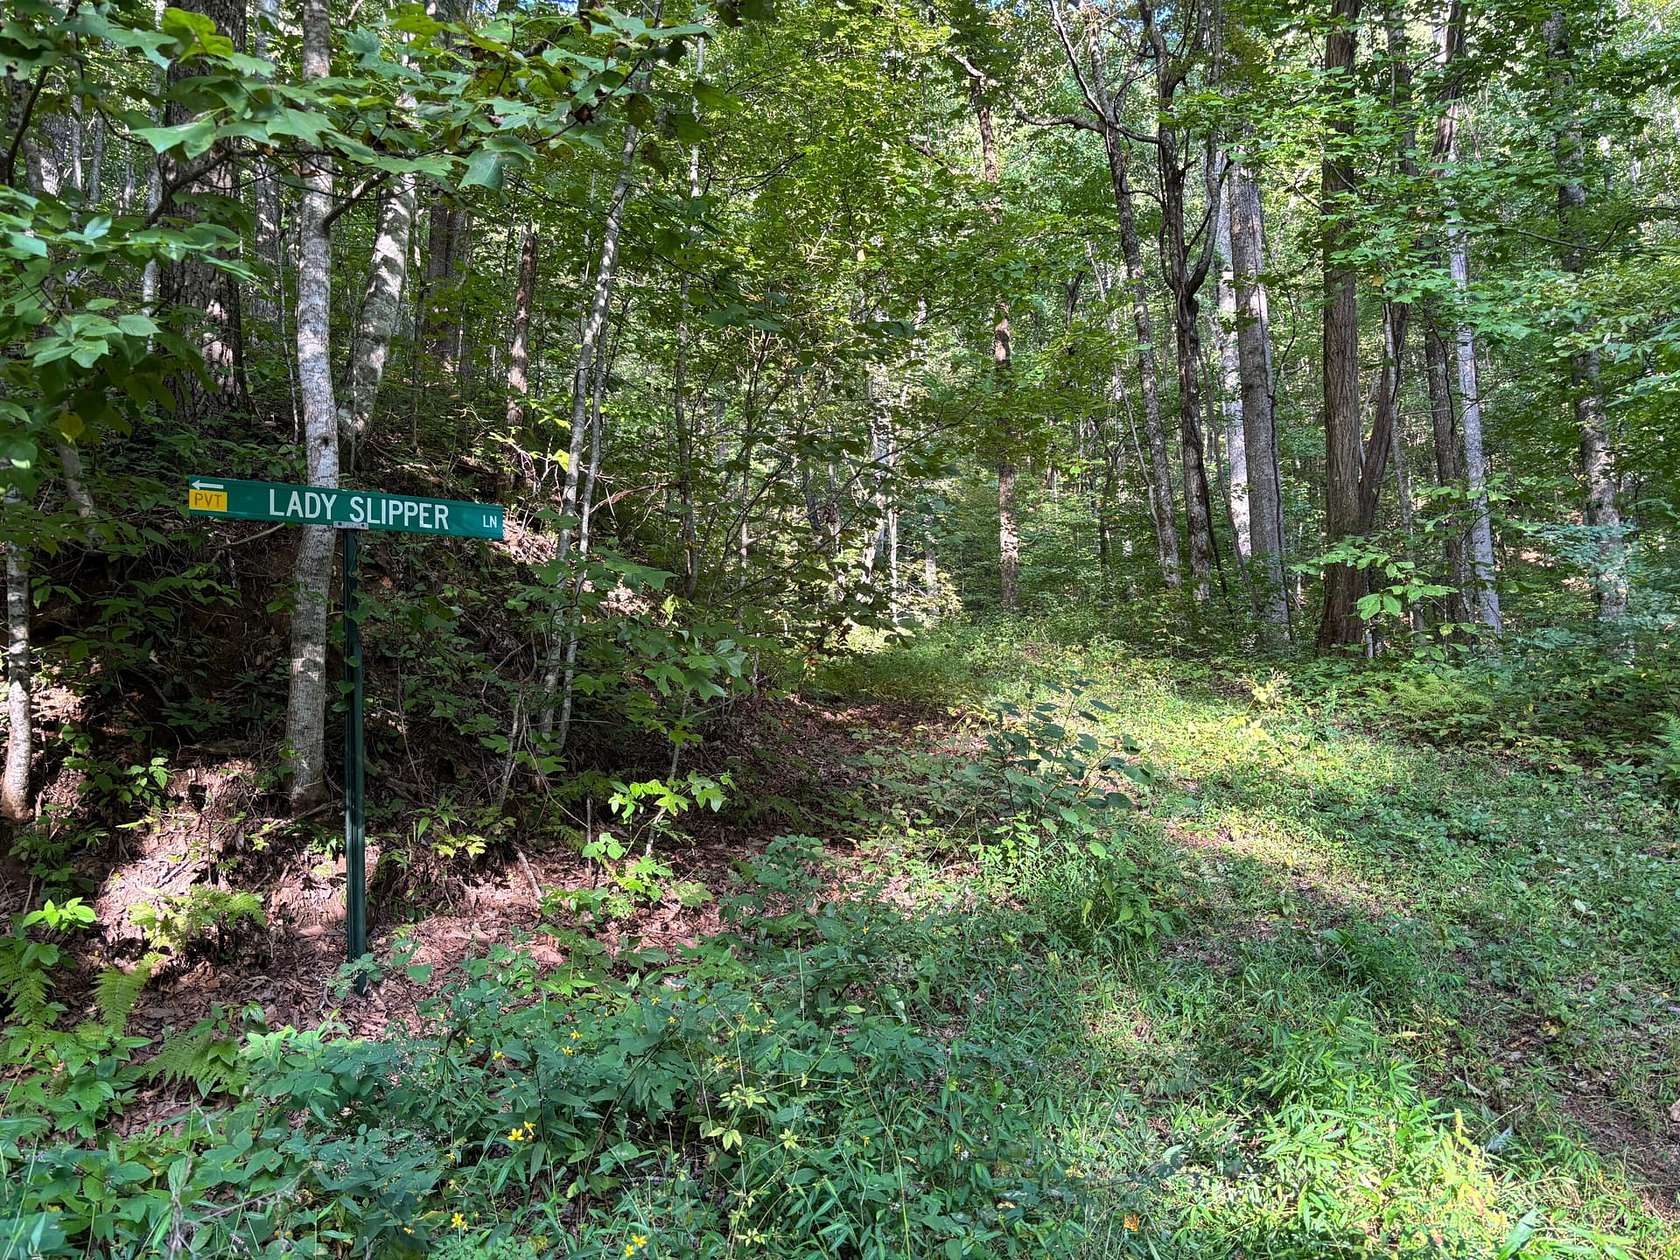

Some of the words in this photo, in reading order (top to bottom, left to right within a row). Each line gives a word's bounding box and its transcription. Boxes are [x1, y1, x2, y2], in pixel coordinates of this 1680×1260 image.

[194, 492, 223, 507] PVT
[269, 489, 337, 520] LADY
[349, 496, 449, 530] SLIPPER
[482, 514, 498, 528] LN
